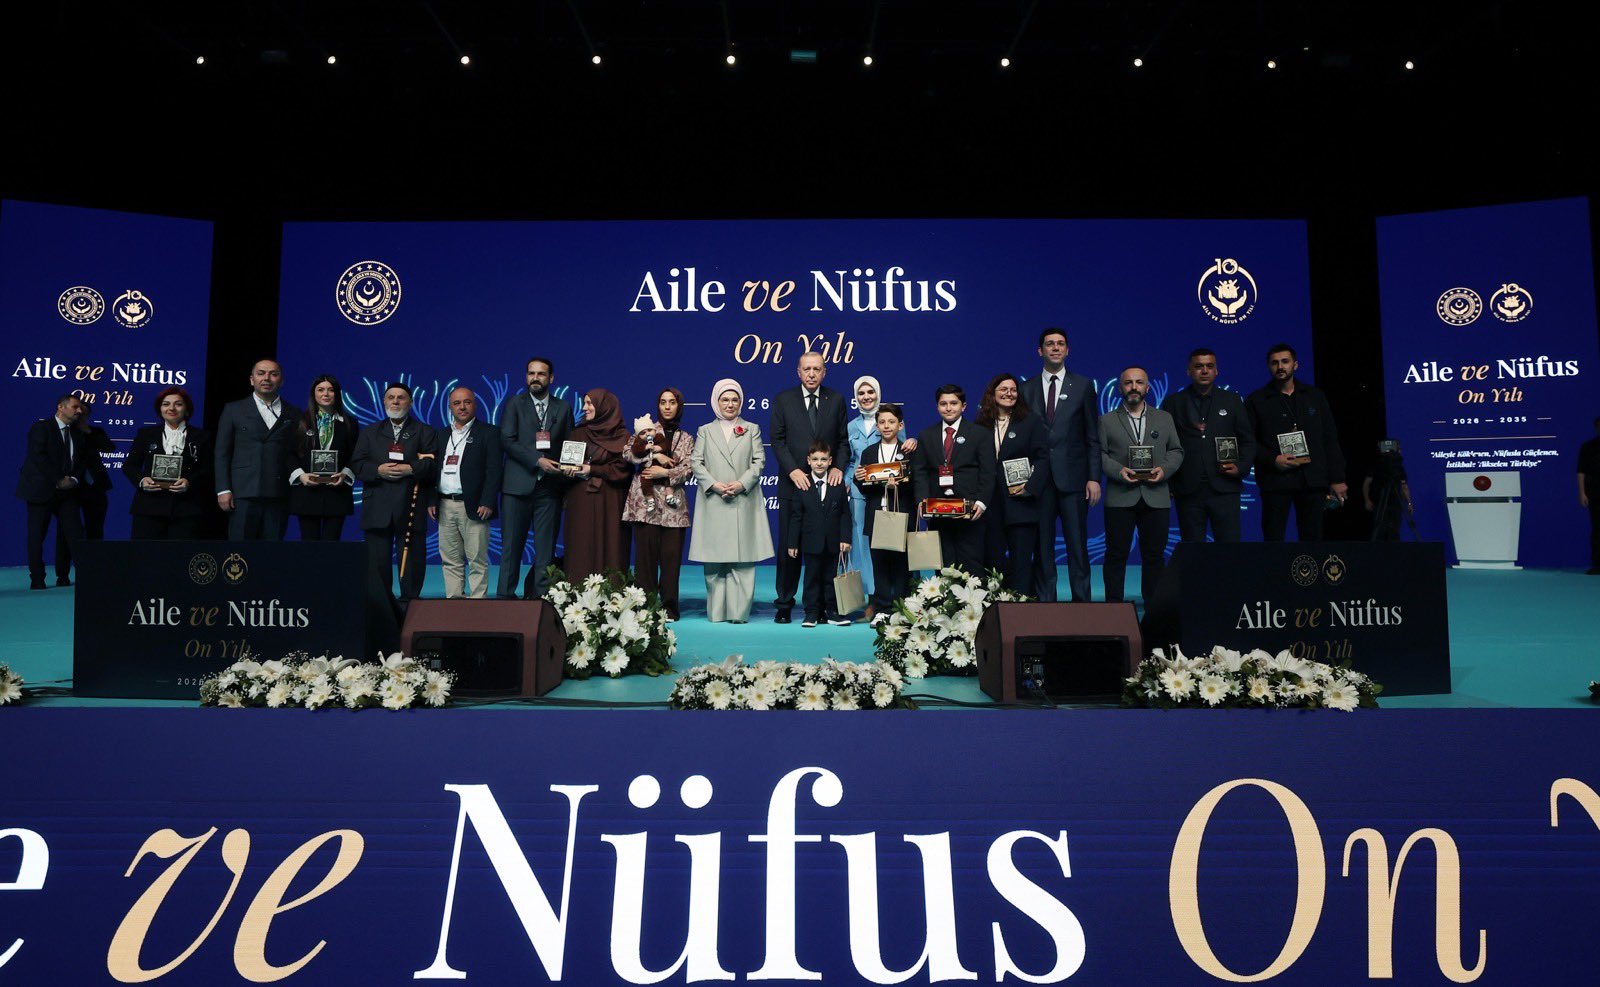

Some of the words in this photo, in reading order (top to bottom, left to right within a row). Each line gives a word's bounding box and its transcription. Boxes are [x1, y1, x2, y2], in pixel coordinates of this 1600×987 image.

[629, 266, 726, 312] Aile
[741, 280, 796, 312] ve
[810, 266, 957, 312] Nüfus
[734, 333, 783, 364] On
[797, 331, 854, 364] Yılı
[12, 357, 67, 380] Aile
[75, 366, 105, 381] ve
[111, 362, 187, 386] Nüfus
[1403, 361, 1454, 384] Aile
[1461, 364, 1490, 381] ve
[1496, 355, 1580, 380] Nüfus
[103, 390, 133, 405] Yılı
[1458, 389, 1485, 404] On
[1491, 387, 1523, 403] Yılı
[108, 418, 134, 426] 2035
[1453, 417, 1480, 425] 2026
[128, 598, 181, 626] Aile
[190, 606, 219, 627] ve
[227, 598, 310, 628] Nüfus
[1235, 600, 1287, 630] Aile
[1295, 607, 1322, 628] ve
[1330, 598, 1403, 628] Nüfus
[184, 639, 212, 658] On
[1292, 640, 1317, 659] On
[106, 826, 365, 983] ve
[413, 766, 1086, 985] Nüfus
[1168, 778, 1487, 984] On
